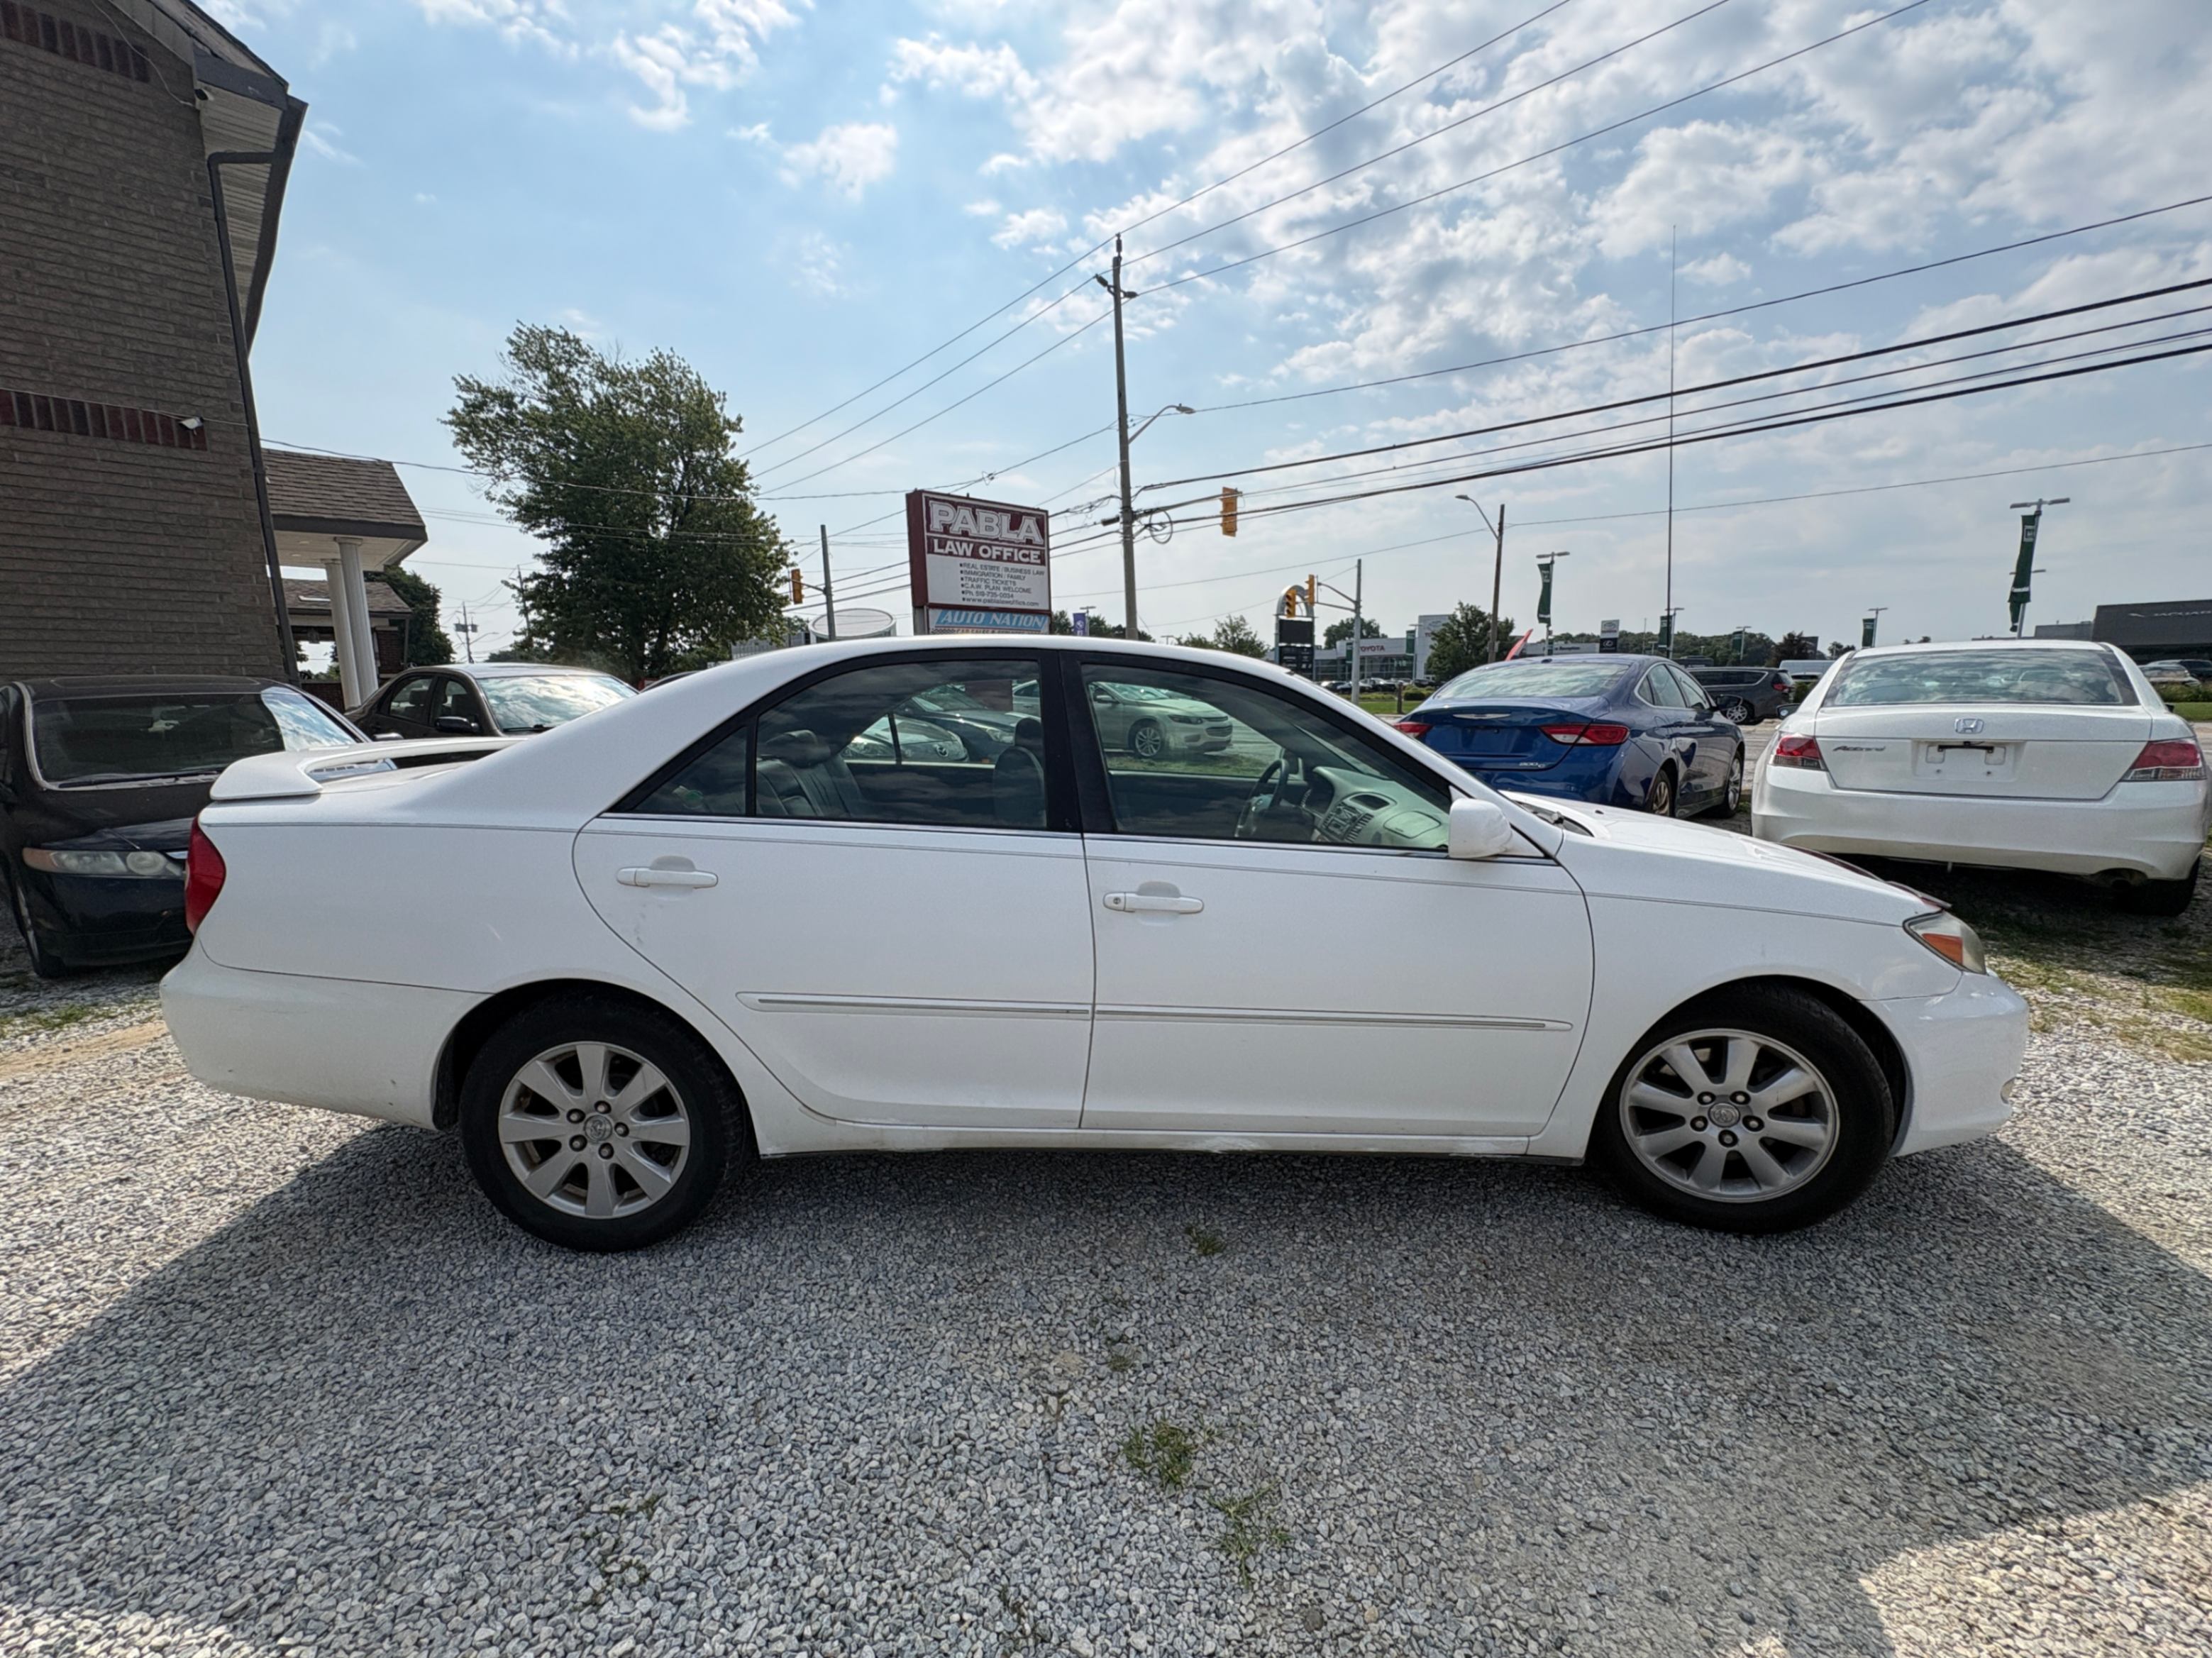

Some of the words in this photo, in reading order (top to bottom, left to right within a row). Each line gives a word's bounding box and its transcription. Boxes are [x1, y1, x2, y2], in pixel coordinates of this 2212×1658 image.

[929, 499, 1044, 545] PABLA
[934, 538, 973, 557] LAW
[979, 546, 1041, 563] OFFICE
[963, 570, 1003, 578] IMMIGRATION
[1004, 566, 1032, 575] BUSINESS
[964, 576, 990, 585] TRAFFIC
[1002, 586, 1032, 595] WELCOME
[941, 610, 985, 624] AUTO
[989, 612, 1044, 628] NATION
